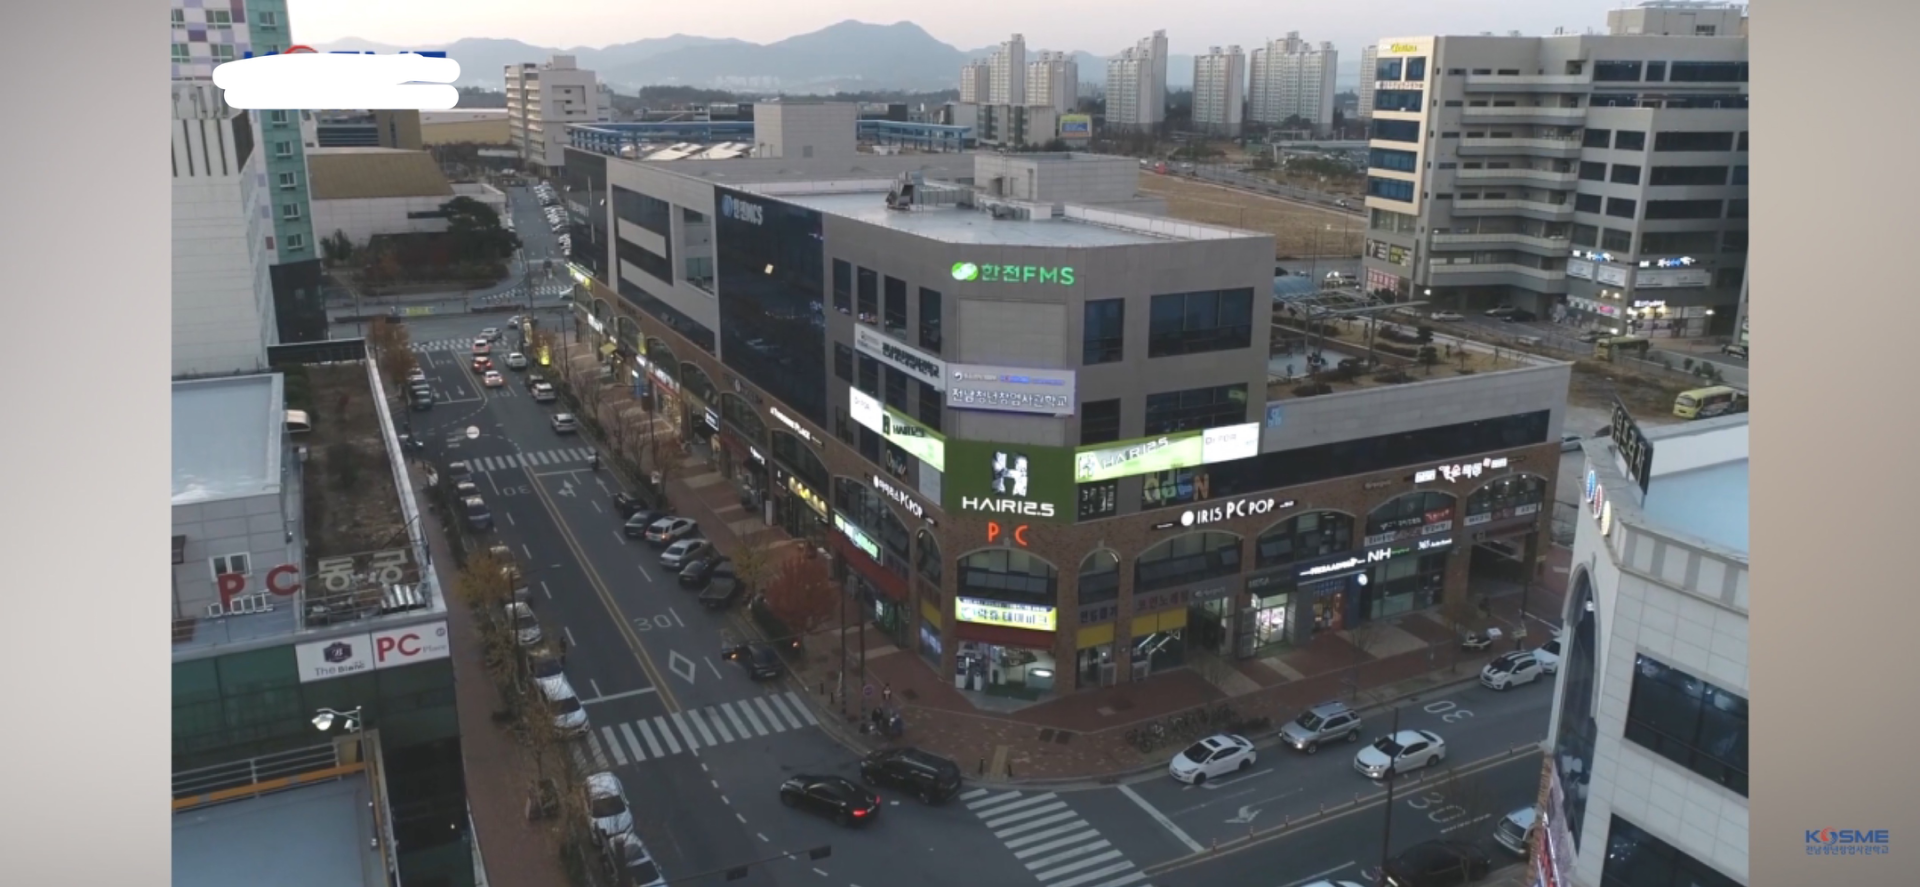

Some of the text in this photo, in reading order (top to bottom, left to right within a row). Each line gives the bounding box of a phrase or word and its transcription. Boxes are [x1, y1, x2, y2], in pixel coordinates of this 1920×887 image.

[981, 263, 1075, 286] 한전FMS
[1197, 498, 1274, 524] IRIS PC POP
[1367, 547, 1392, 563] NH
[633, 614, 672, 631] 30
[376, 633, 422, 662] PC
[315, 665, 340, 677] The
[1424, 700, 1474, 723] 30
[1408, 791, 1467, 823] 30
